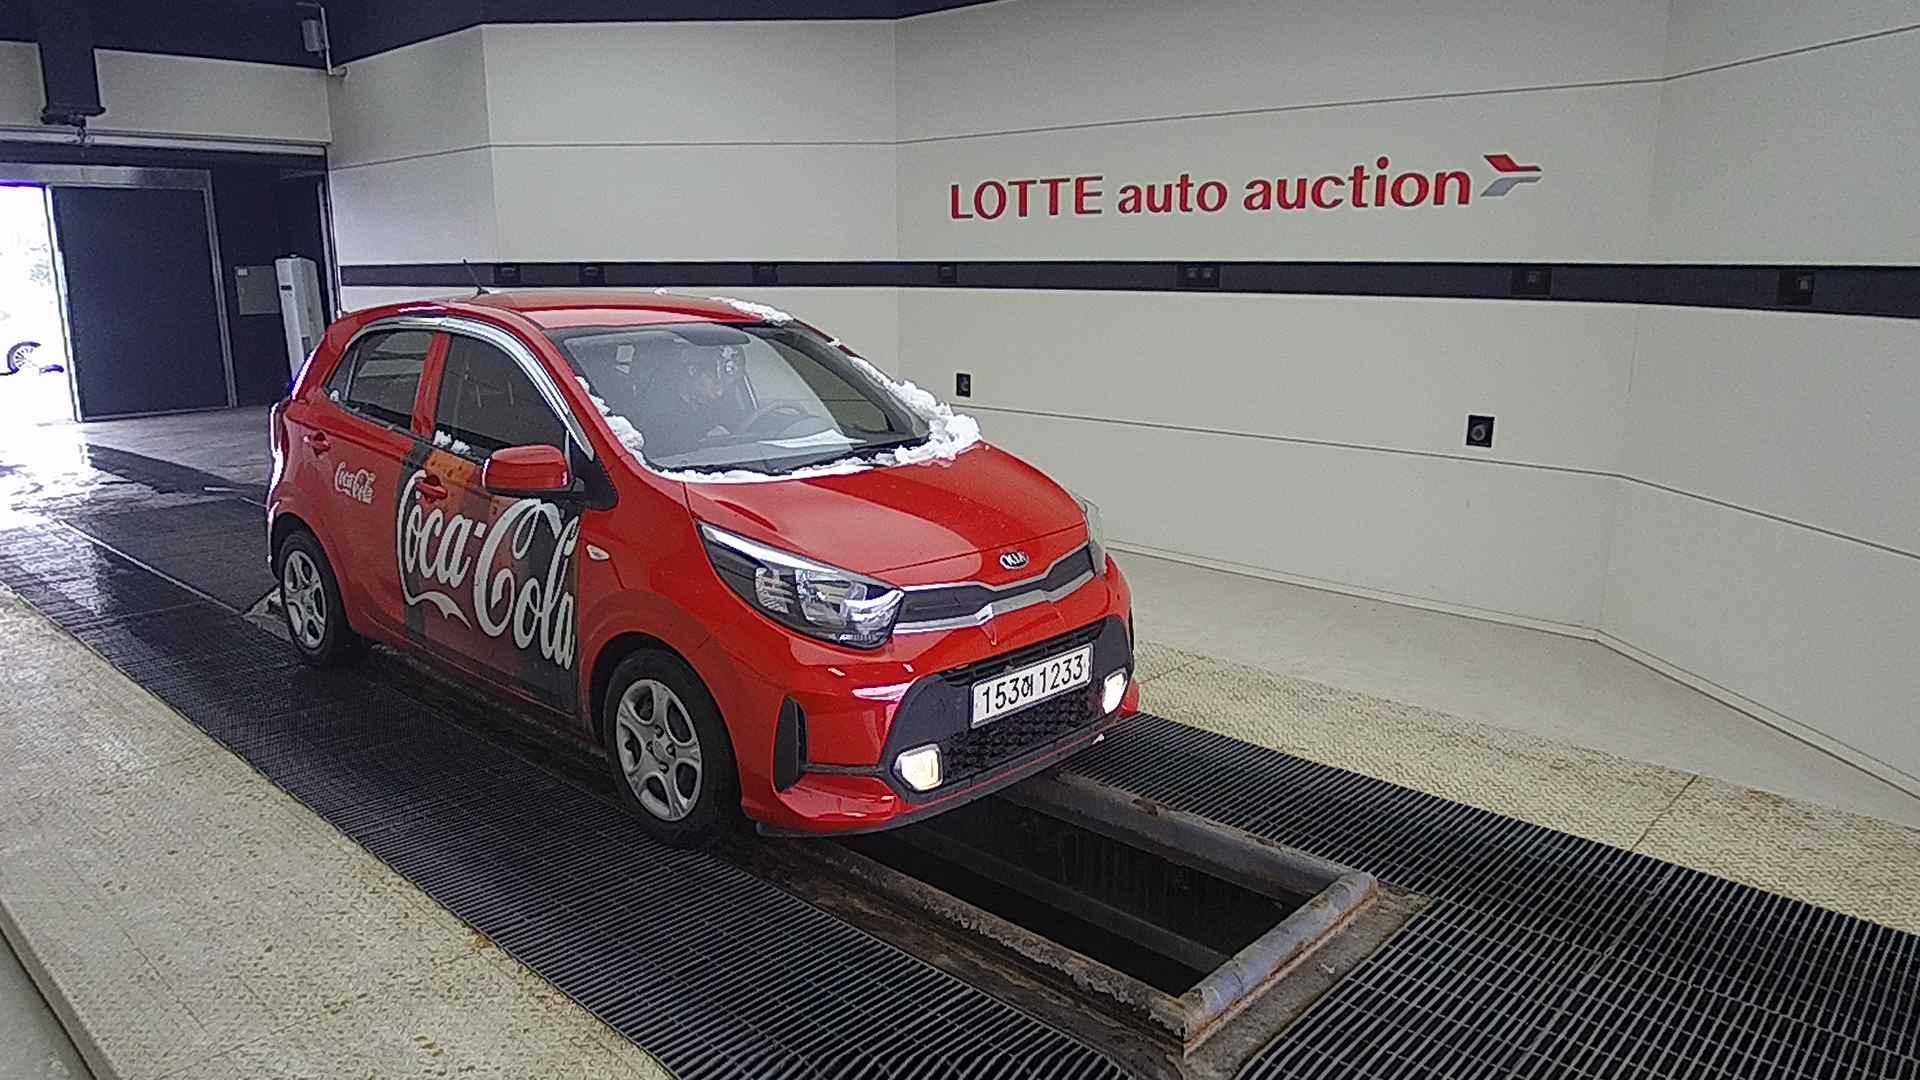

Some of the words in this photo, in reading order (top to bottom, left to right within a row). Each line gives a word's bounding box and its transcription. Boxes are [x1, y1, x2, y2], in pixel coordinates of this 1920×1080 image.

[950, 176, 1104, 219] LOTTE
[1118, 173, 1228, 214] auto
[1243, 156, 1472, 211] auction
[1003, 551, 1027, 566] KIA
[1039, 653, 1084, 694] 1233
